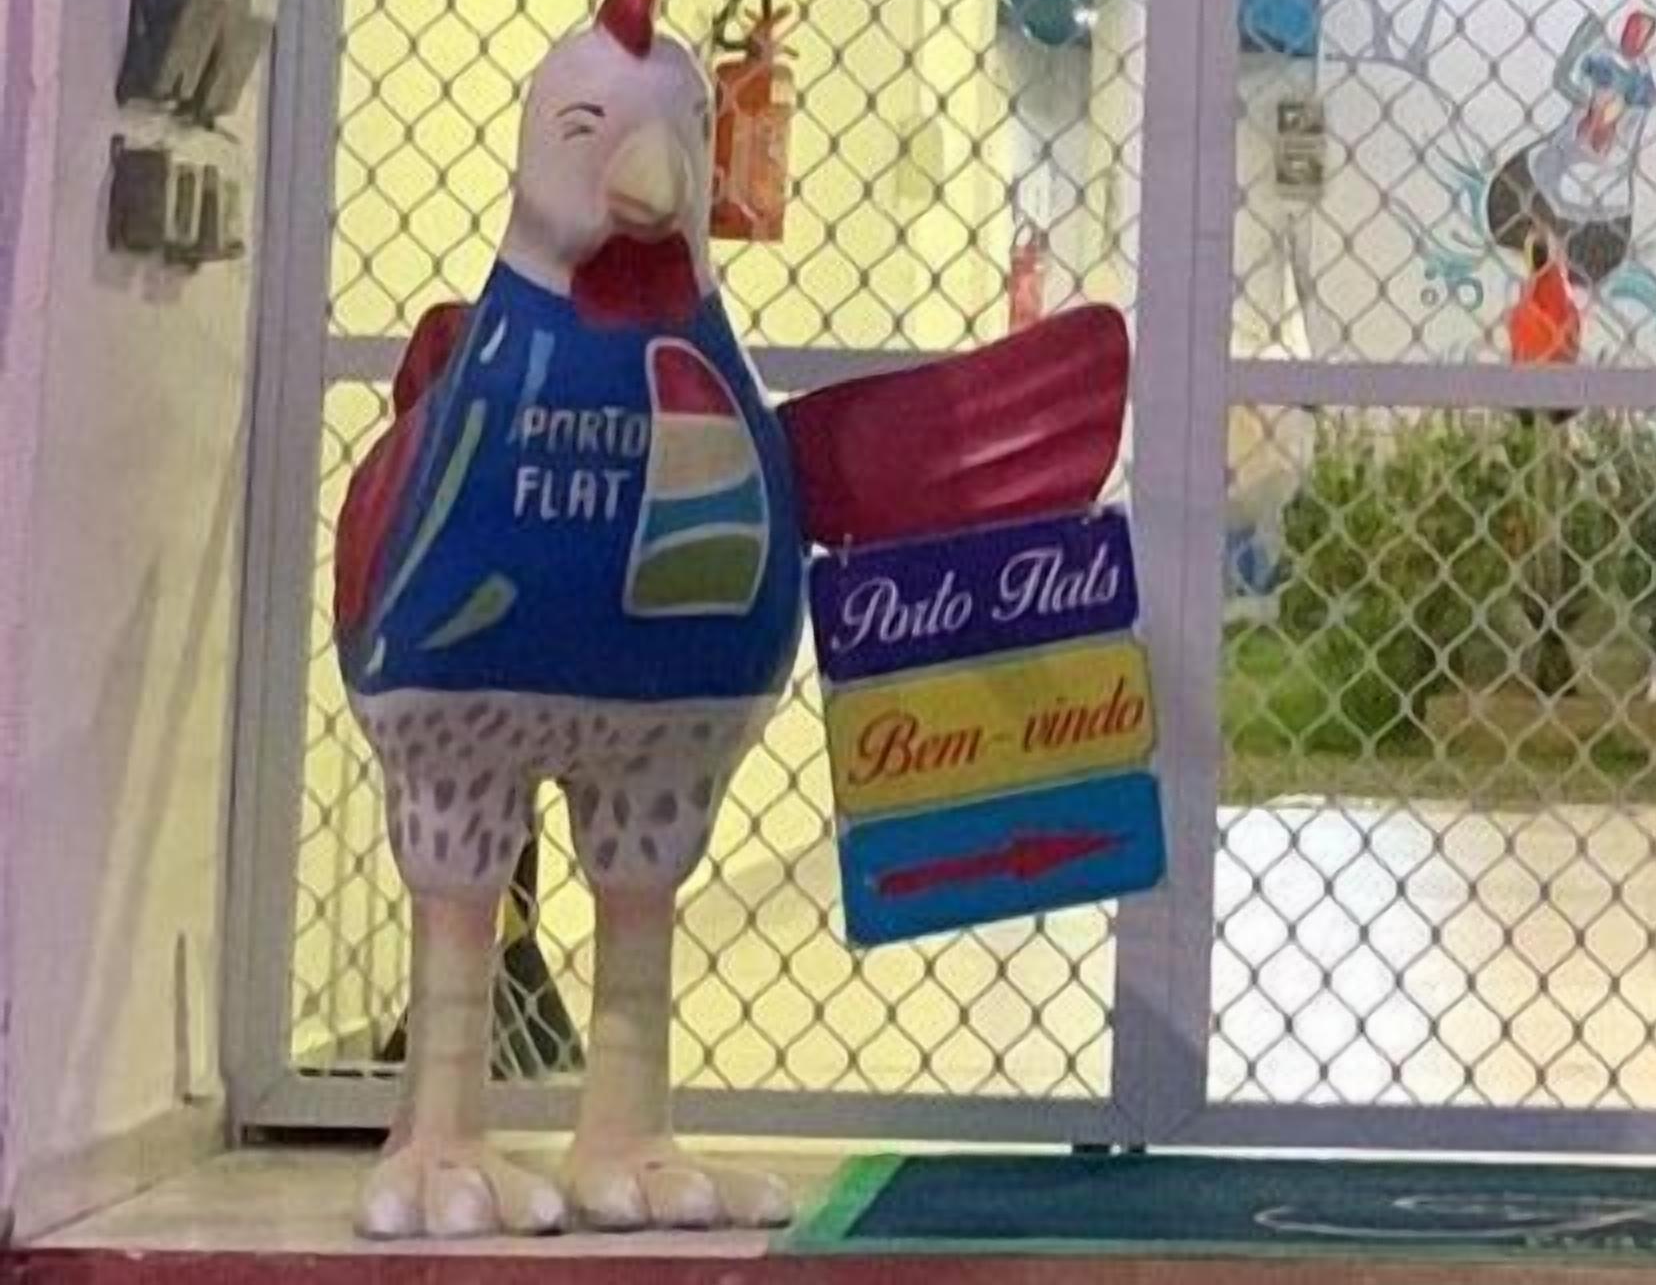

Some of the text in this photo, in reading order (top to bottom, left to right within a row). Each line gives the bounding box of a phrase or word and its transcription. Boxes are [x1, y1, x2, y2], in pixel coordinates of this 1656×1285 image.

[513, 466, 631, 521] FLAT
[830, 543, 1120, 652] Porto Flats
